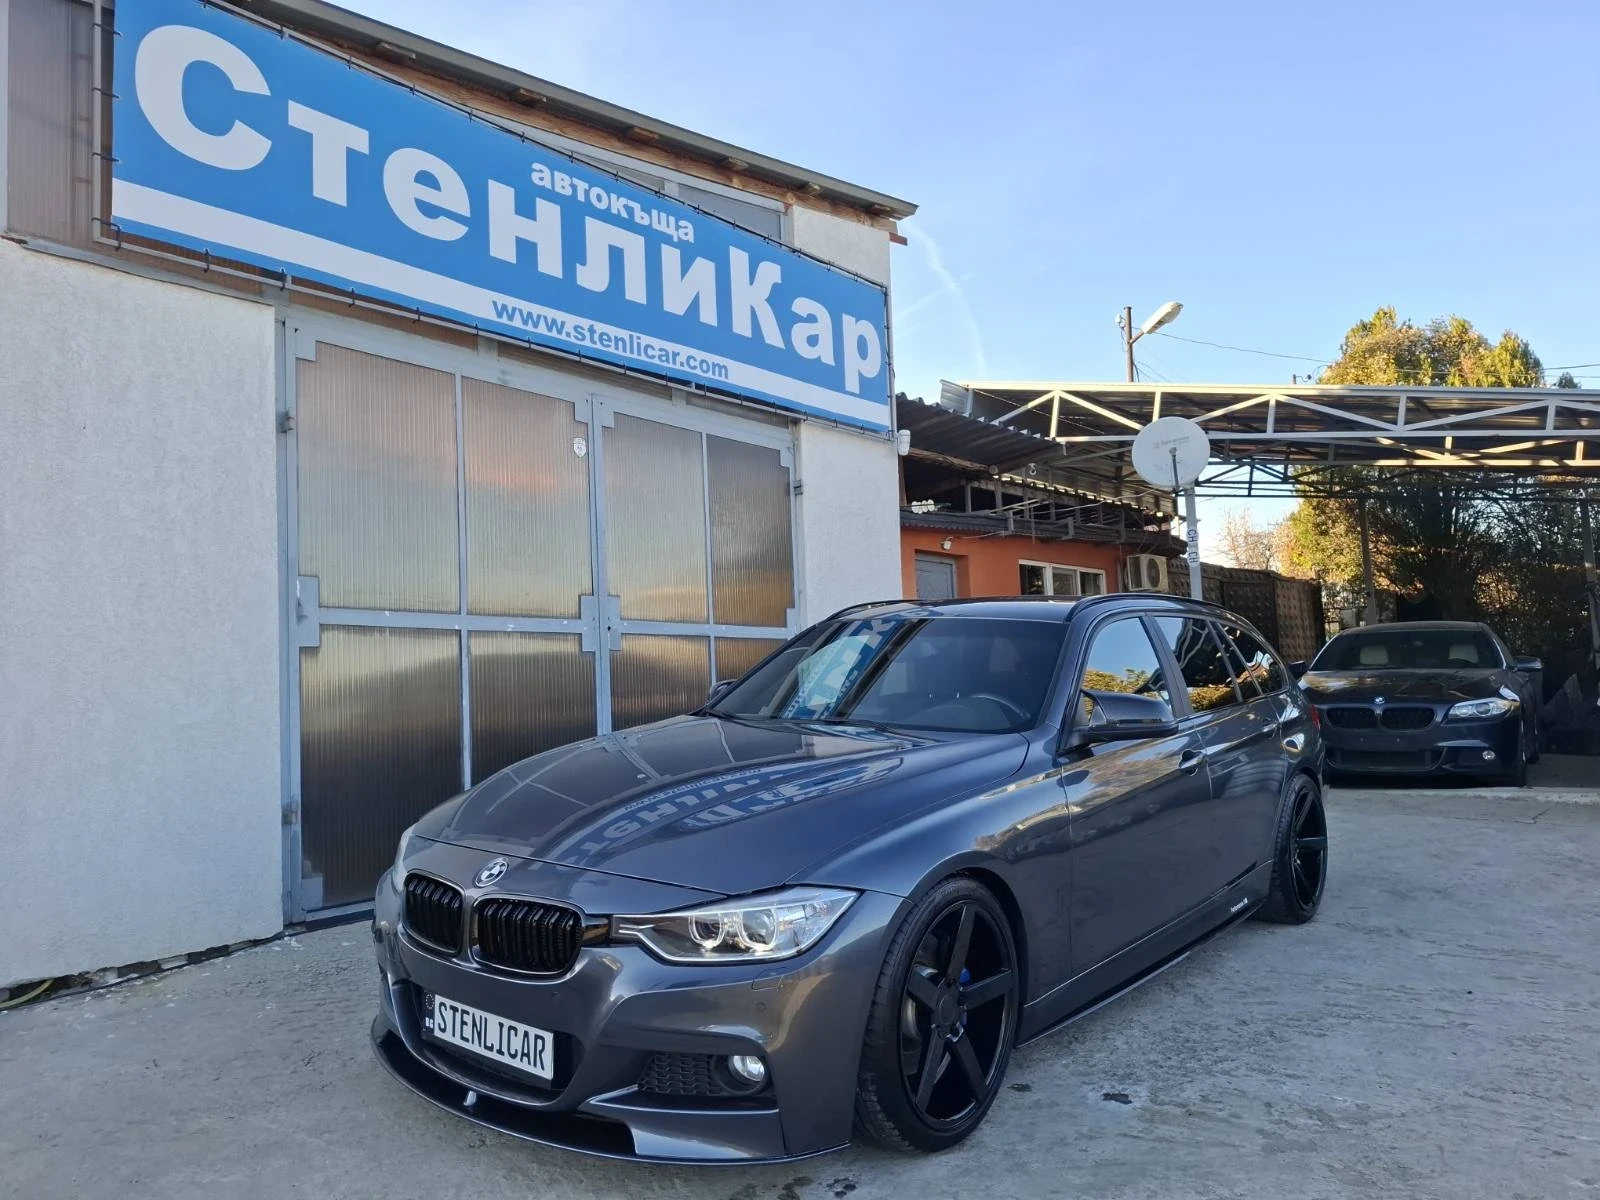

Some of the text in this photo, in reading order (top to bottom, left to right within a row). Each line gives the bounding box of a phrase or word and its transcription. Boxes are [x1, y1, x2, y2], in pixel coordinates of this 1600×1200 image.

[134, 24, 881, 394] СтенлиКар
[530, 162, 695, 243] автокъща
[491, 299, 729, 380] www.stenlicar.com
[437, 1001, 546, 1071] STENLICAR
